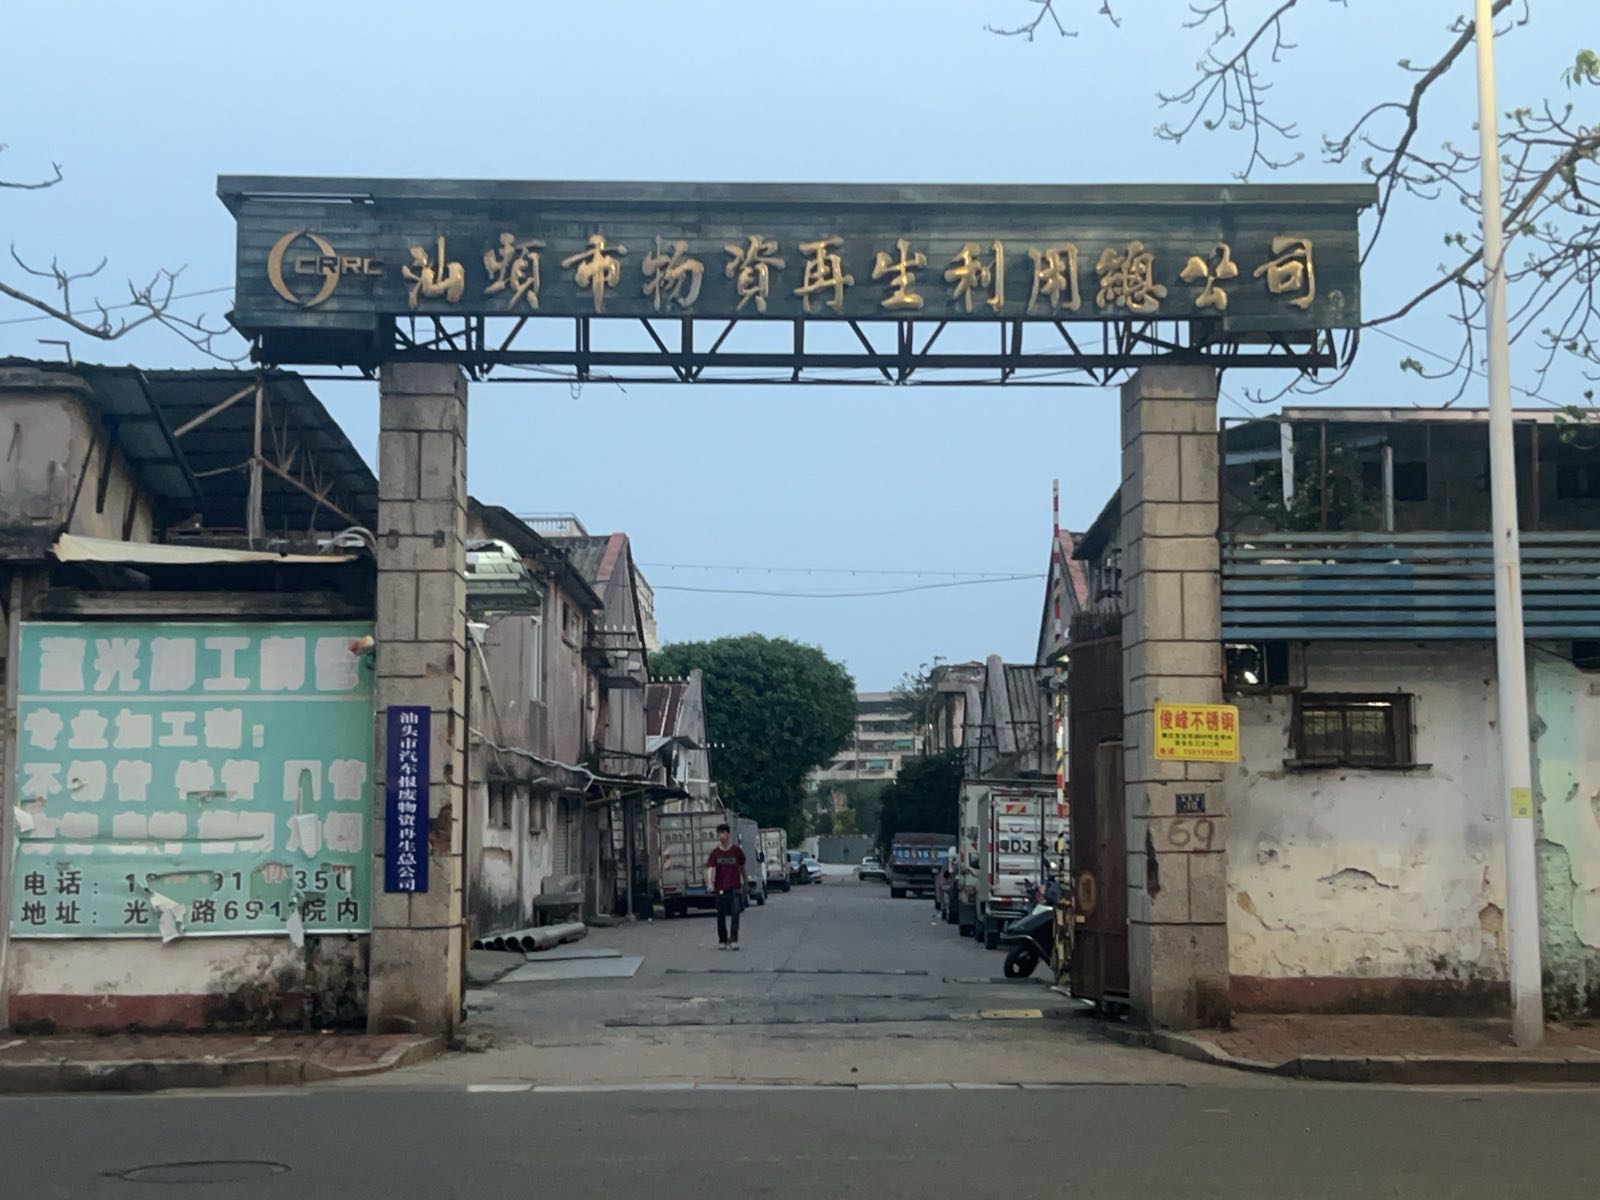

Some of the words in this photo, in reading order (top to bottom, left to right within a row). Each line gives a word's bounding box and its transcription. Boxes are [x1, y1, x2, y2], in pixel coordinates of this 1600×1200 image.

[397, 711, 419, 891] 汕头市汽车报废物资再生总公司
[1167, 818, 1215, 851] 69
